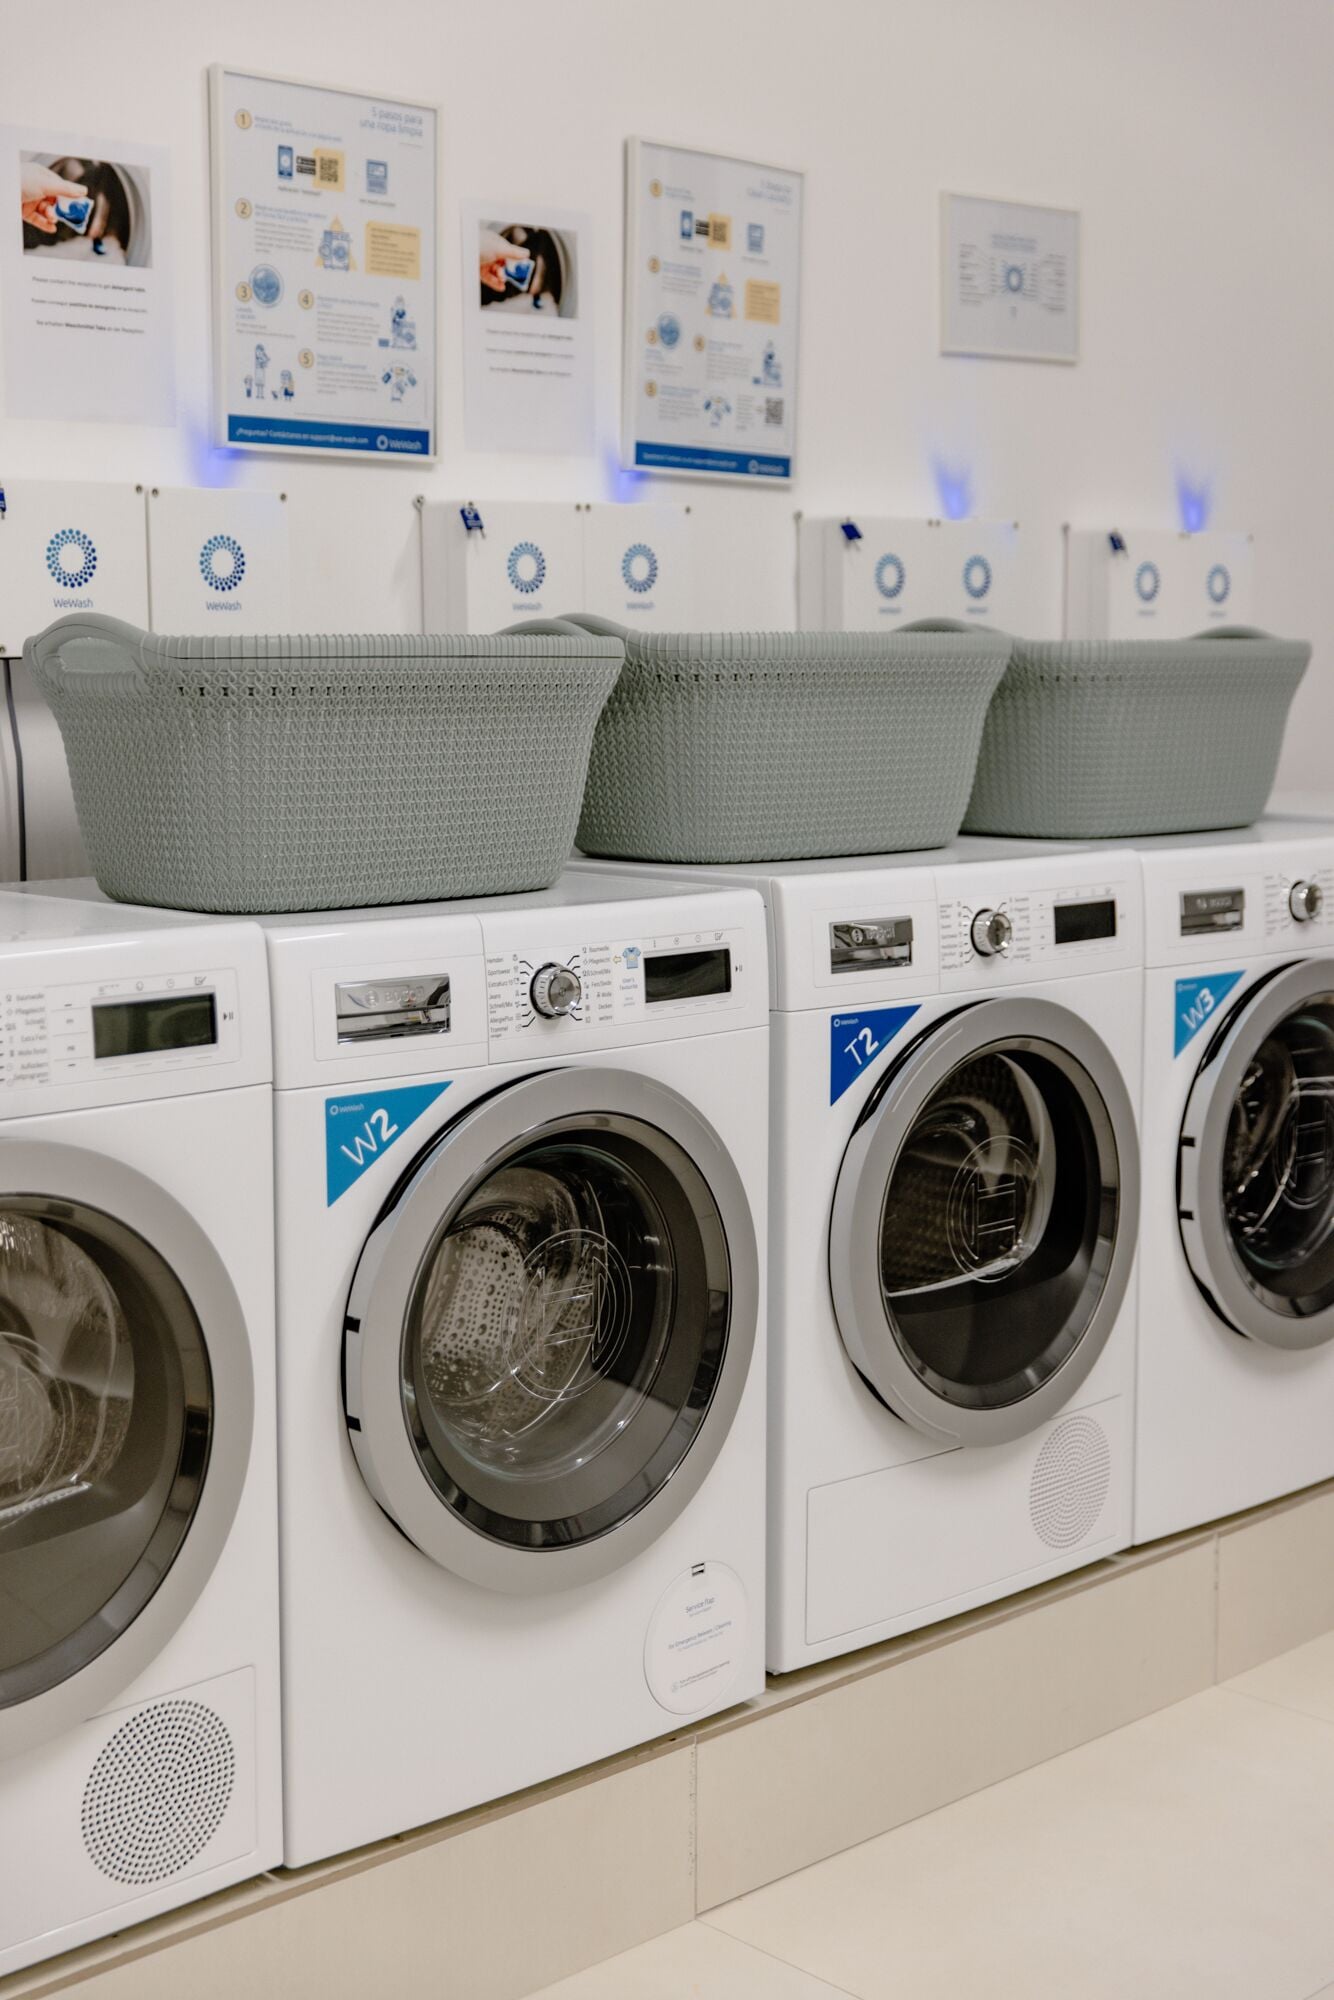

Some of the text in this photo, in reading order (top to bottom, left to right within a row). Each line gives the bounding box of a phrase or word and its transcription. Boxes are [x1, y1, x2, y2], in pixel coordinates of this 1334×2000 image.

[371, 106, 423, 125] 5 pasos para
[360, 119, 423, 138] una ropa limpia
[302, 293, 309, 305] 4
[303, 353, 309, 365] 5
[389, 438, 422, 450] WeWash
[53, 598, 94, 608] WeWash
[206, 601, 242, 611] WeWash
[1182, 987, 1215, 1030] W3
[844, 1027, 880, 1066] T2
[339, 1102, 365, 1113] WeWash
[341, 1108, 399, 1165] W2
[686, 1601, 704, 1614] Service
